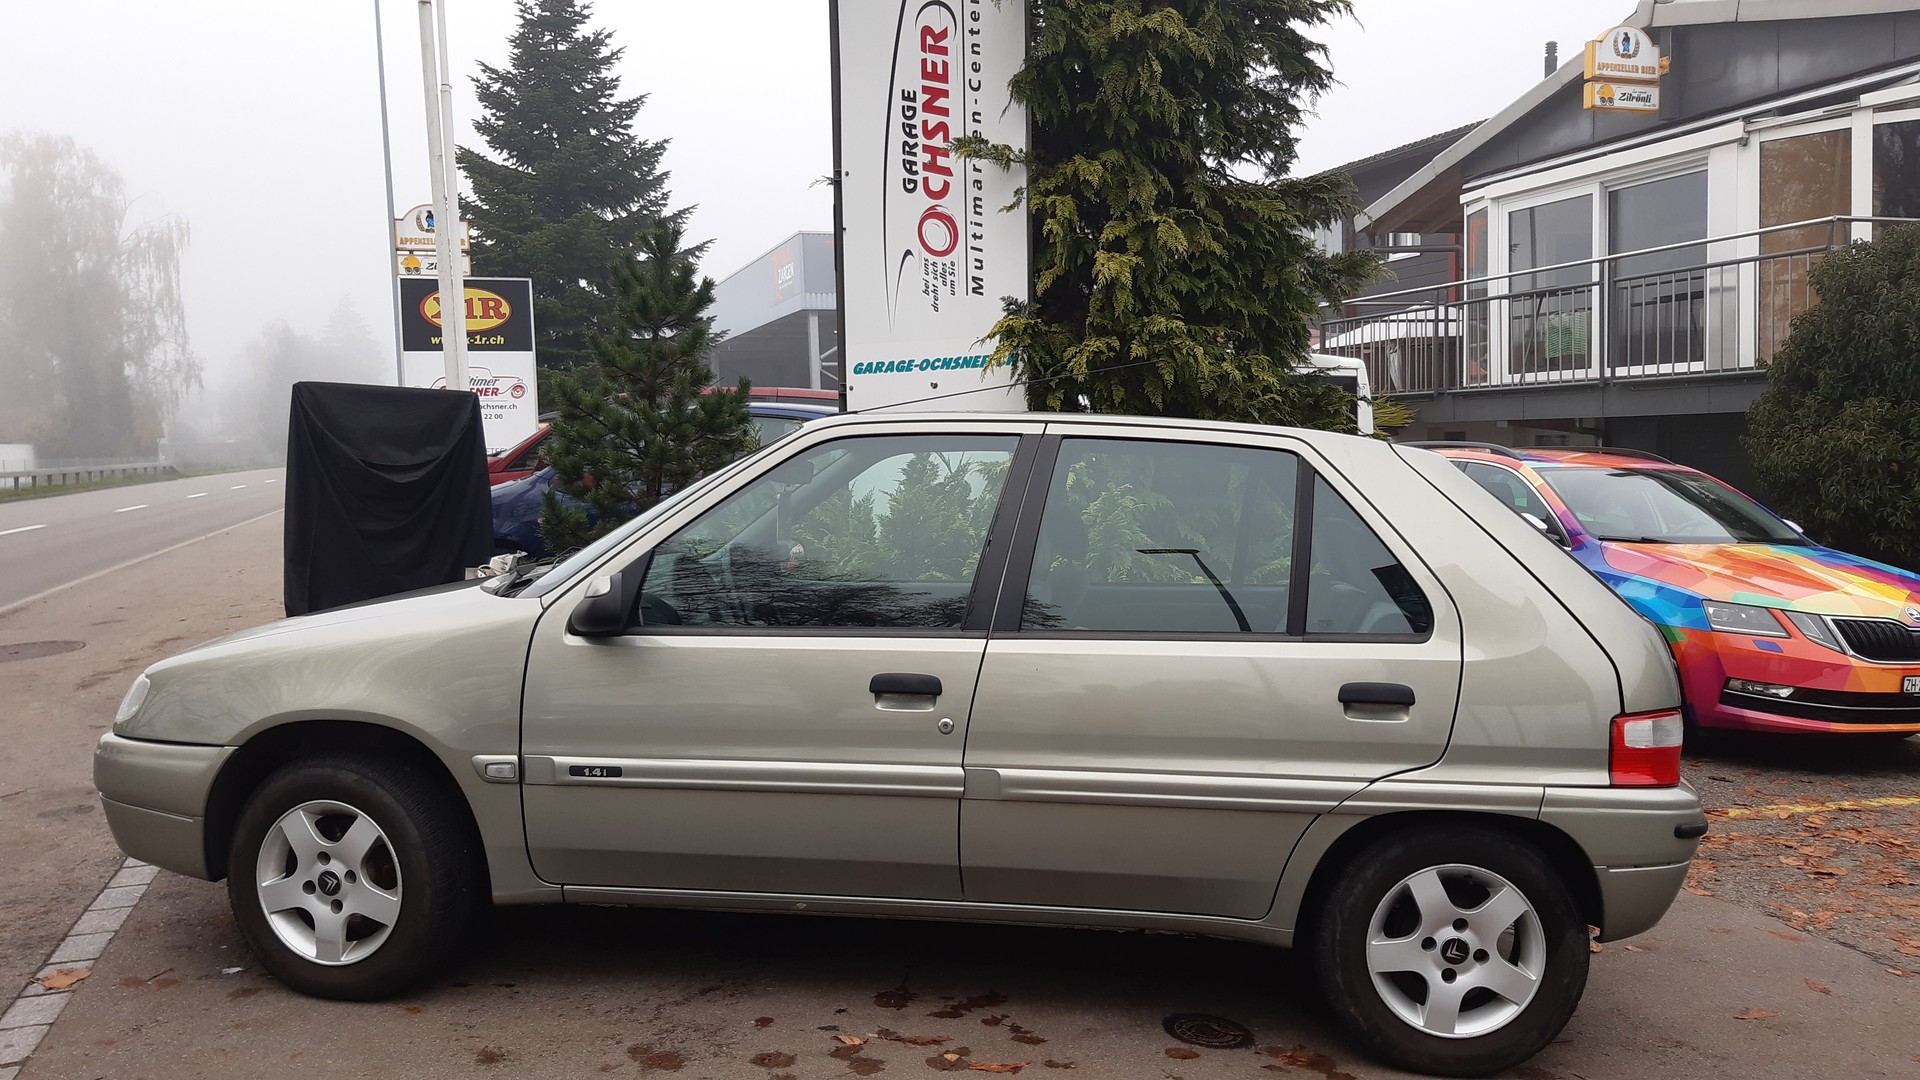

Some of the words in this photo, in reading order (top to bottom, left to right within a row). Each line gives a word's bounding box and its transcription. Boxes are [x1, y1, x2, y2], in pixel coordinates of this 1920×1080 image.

[1597, 62, 1639, 73] APPENZELLER
[901, 88, 919, 194] GARAGE
[930, 261, 939, 282] sich
[939, 262, 948, 287] alles
[948, 261, 956, 278] Sie
[922, 278, 930, 297] bei
[949, 279, 956, 296] um
[930, 284, 939, 313] dreht
